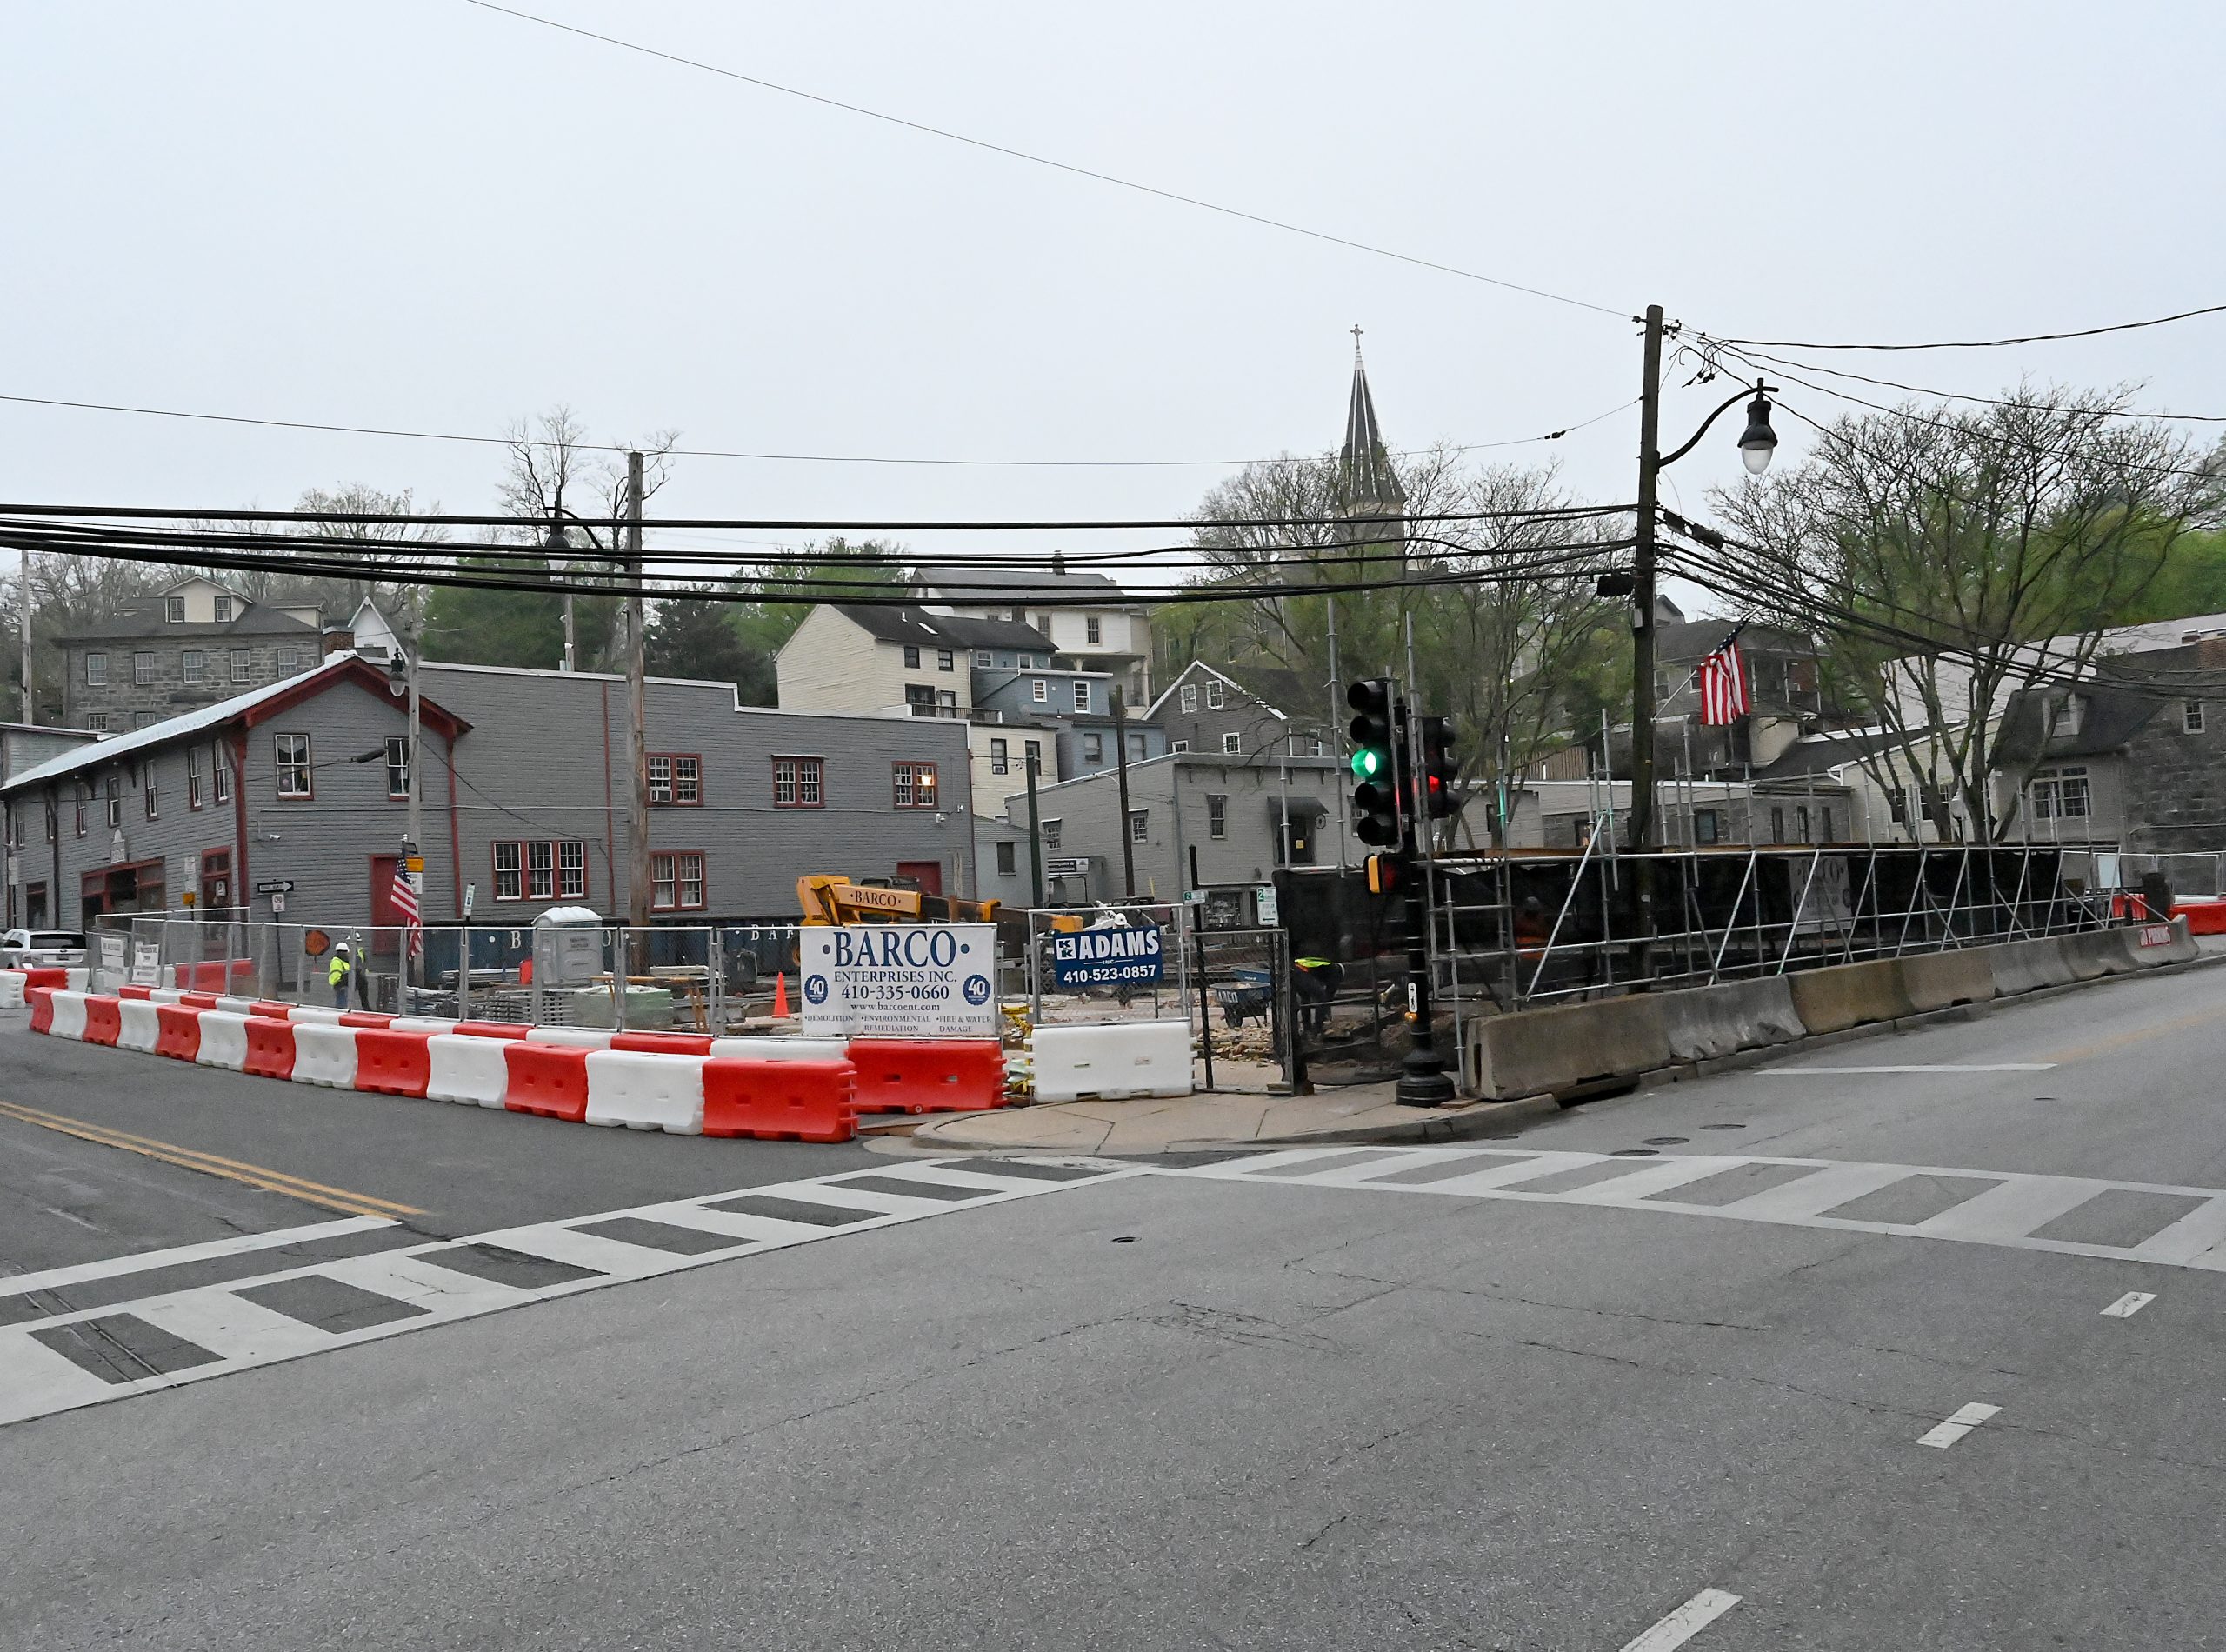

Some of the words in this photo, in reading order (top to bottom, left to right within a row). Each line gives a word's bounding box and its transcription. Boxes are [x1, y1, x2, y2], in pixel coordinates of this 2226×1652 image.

[855, 890, 897, 907] BARCO
[833, 930, 956, 968] BARCO
[1079, 929, 1160, 960] ADAMS
[834, 971, 924, 983] ENTERPRISES
[929, 971, 957, 983] INC.
[1063, 964, 1156, 983] 410-523-0857
[809, 978, 825, 995] 40
[841, 984, 950, 1000] 410-335-0660
[968, 978, 986, 996] 40
[850, 1002, 940, 1011] www.barcoent.com
